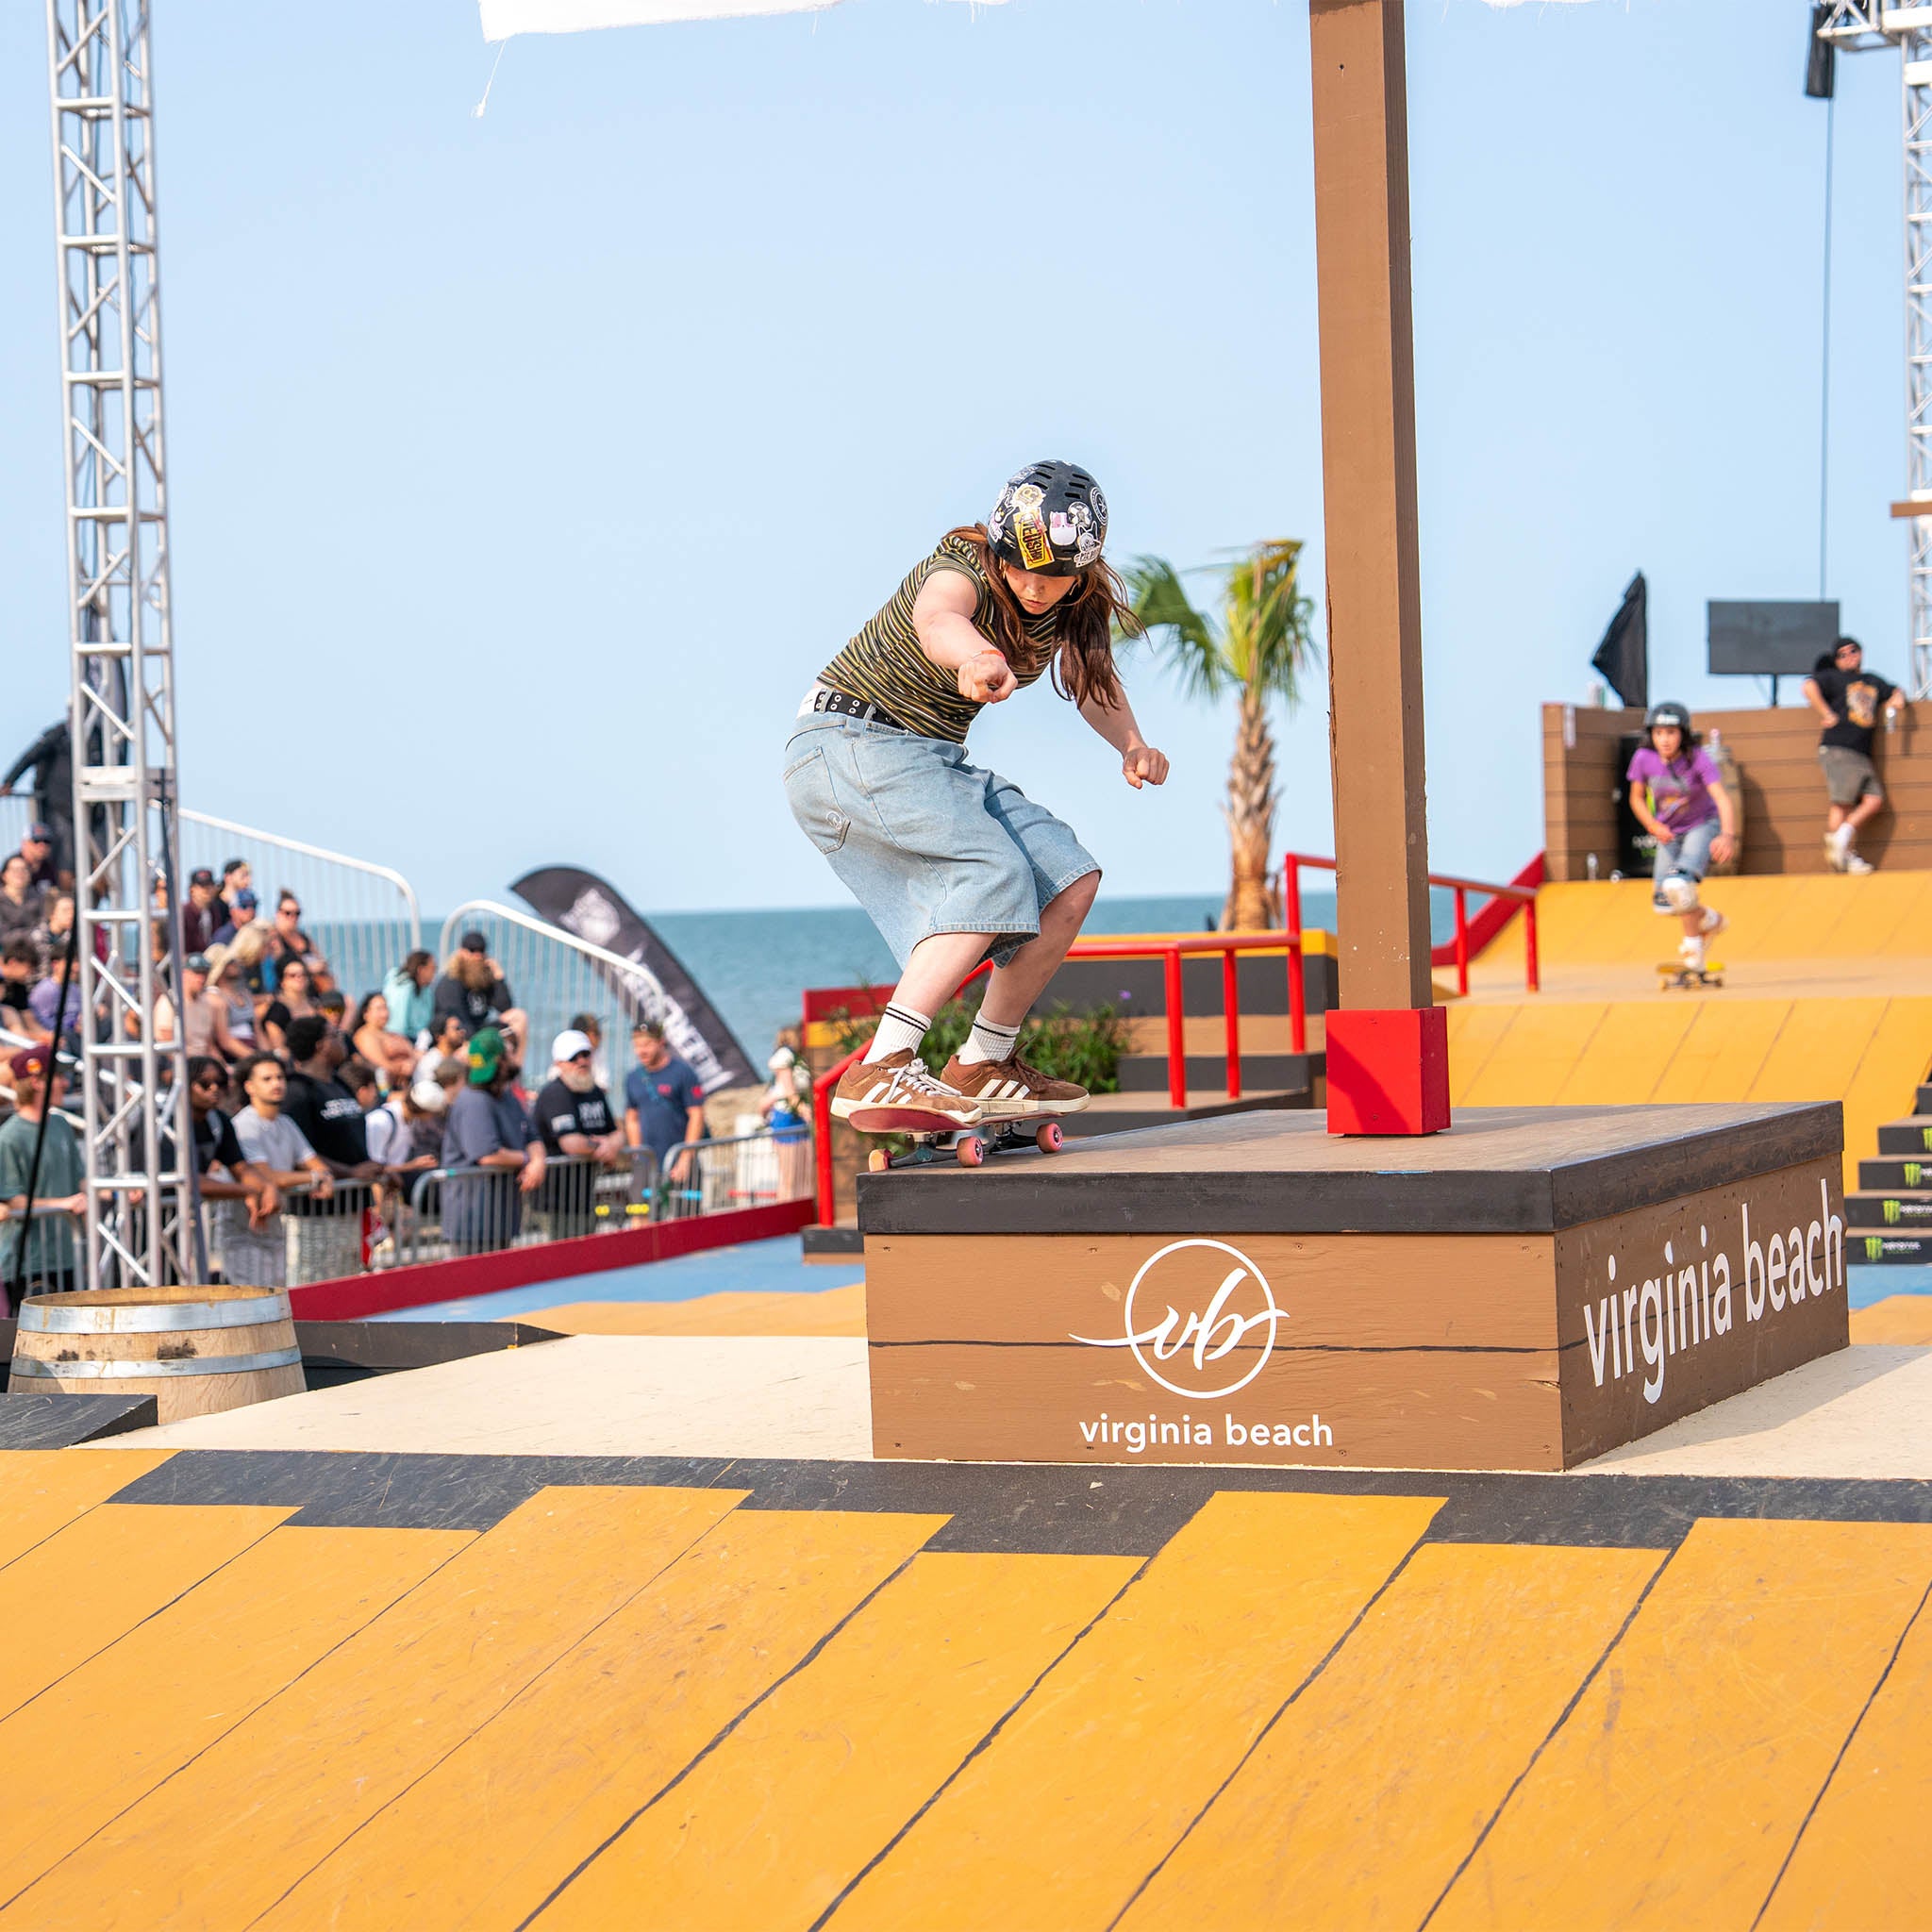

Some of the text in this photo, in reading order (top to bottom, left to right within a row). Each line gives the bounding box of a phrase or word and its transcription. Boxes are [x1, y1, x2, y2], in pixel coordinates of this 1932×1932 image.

[1584, 1179, 1842, 1405] virginia beach
[1079, 1413, 1333, 1453] virginia beach
